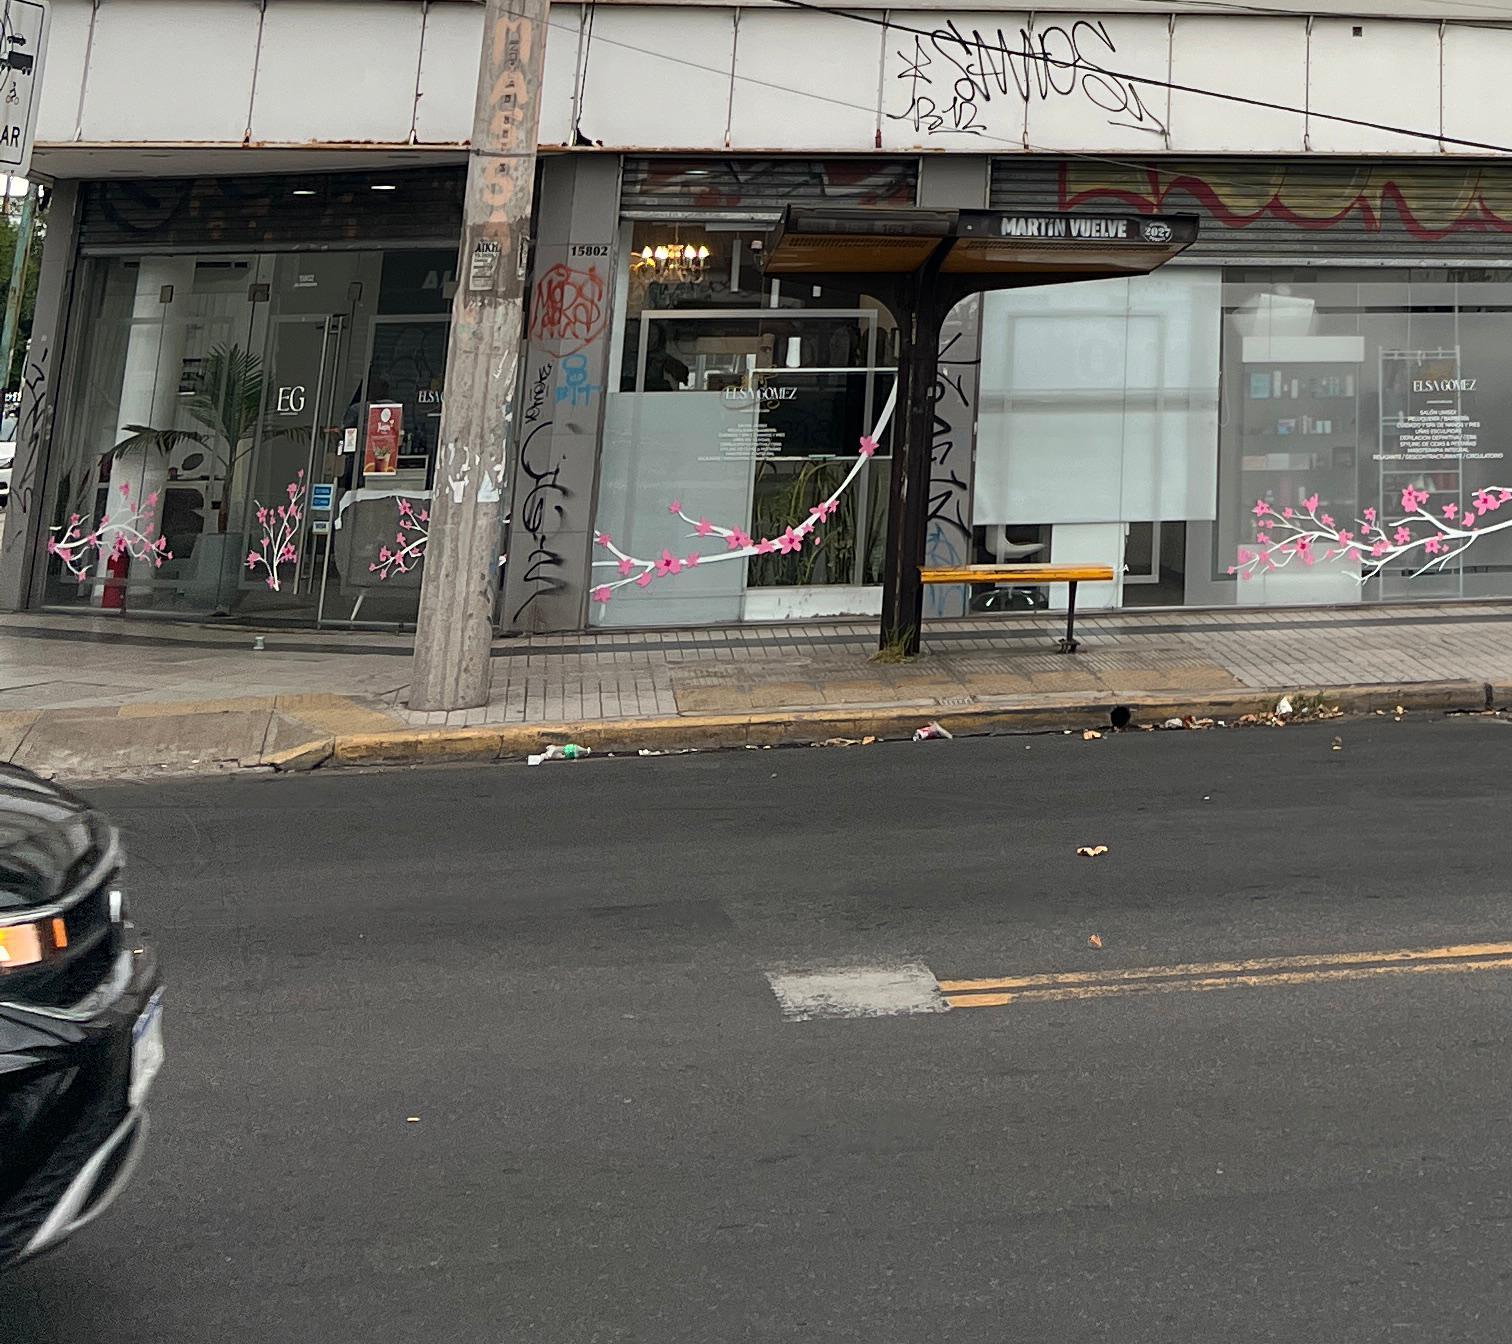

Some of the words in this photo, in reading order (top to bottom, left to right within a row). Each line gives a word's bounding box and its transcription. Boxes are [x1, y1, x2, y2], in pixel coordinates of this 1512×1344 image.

[1070, 218, 1127, 238] VUELVE
[1145, 226, 1171, 238] 2027
[571, 245, 609, 257] 15802
[277, 385, 306, 413] EG
